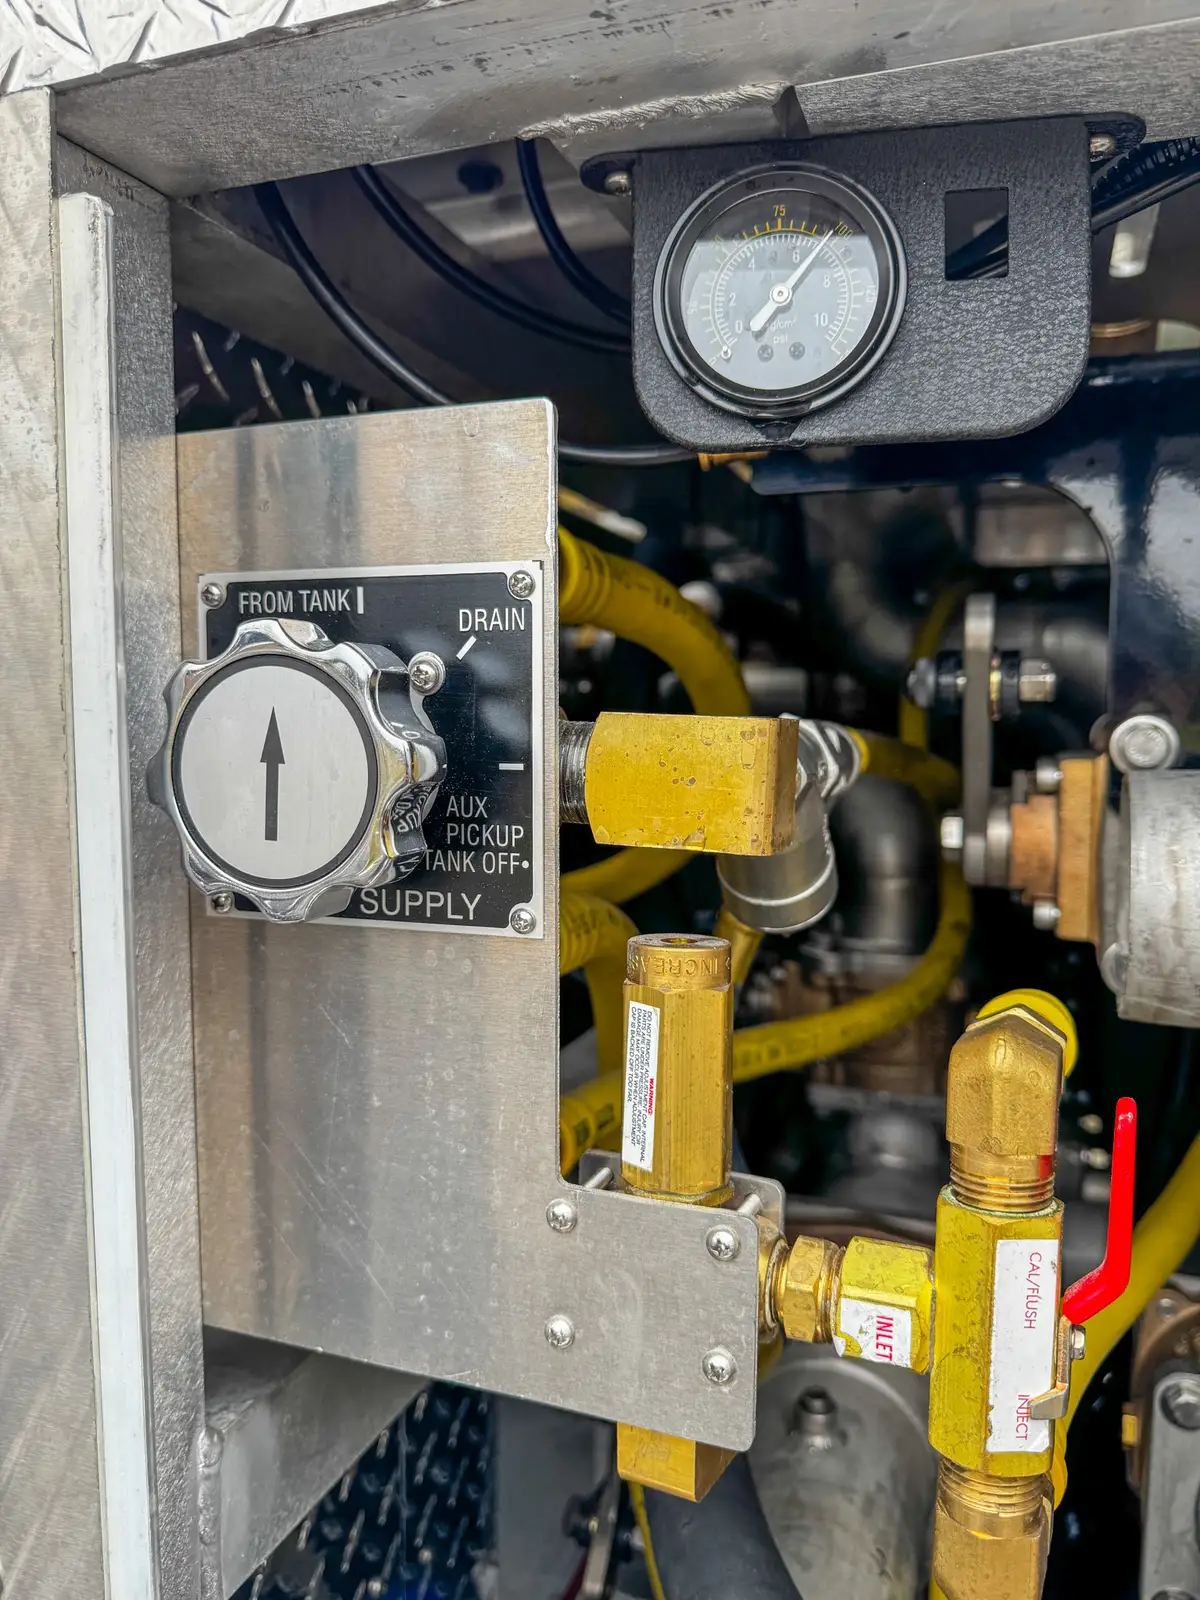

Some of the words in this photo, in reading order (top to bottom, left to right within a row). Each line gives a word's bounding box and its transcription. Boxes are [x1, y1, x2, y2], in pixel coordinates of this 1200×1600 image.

[772, 204, 786, 217] 75
[834, 220, 854, 240] 100
[748, 256, 756, 272] 4
[792, 249, 800, 264] 6
[823, 274, 831, 288] 8
[729, 292, 737, 306] 2
[735, 320, 743, 334] 0
[813, 312, 828, 327] 10
[773, 332, 788, 344] psi
[238, 591, 294, 614] FROM
[299, 589, 350, 612] TANK
[458, 608, 526, 632] DRAIN
[446, 796, 488, 819] AUX
[446, 823, 525, 848] PICKUP
[424, 849, 476, 873] TANK
[482, 851, 520, 875] OFF
[360, 888, 482, 920] SUPPLY
[647, 1011, 652, 1022] DO
[636, 1135, 641, 1145] OR
[1024, 1252, 1042, 1330] CAL/FLUSH
[876, 1315, 894, 1361] INLET
[1016, 1394, 1031, 1440] INJECT
